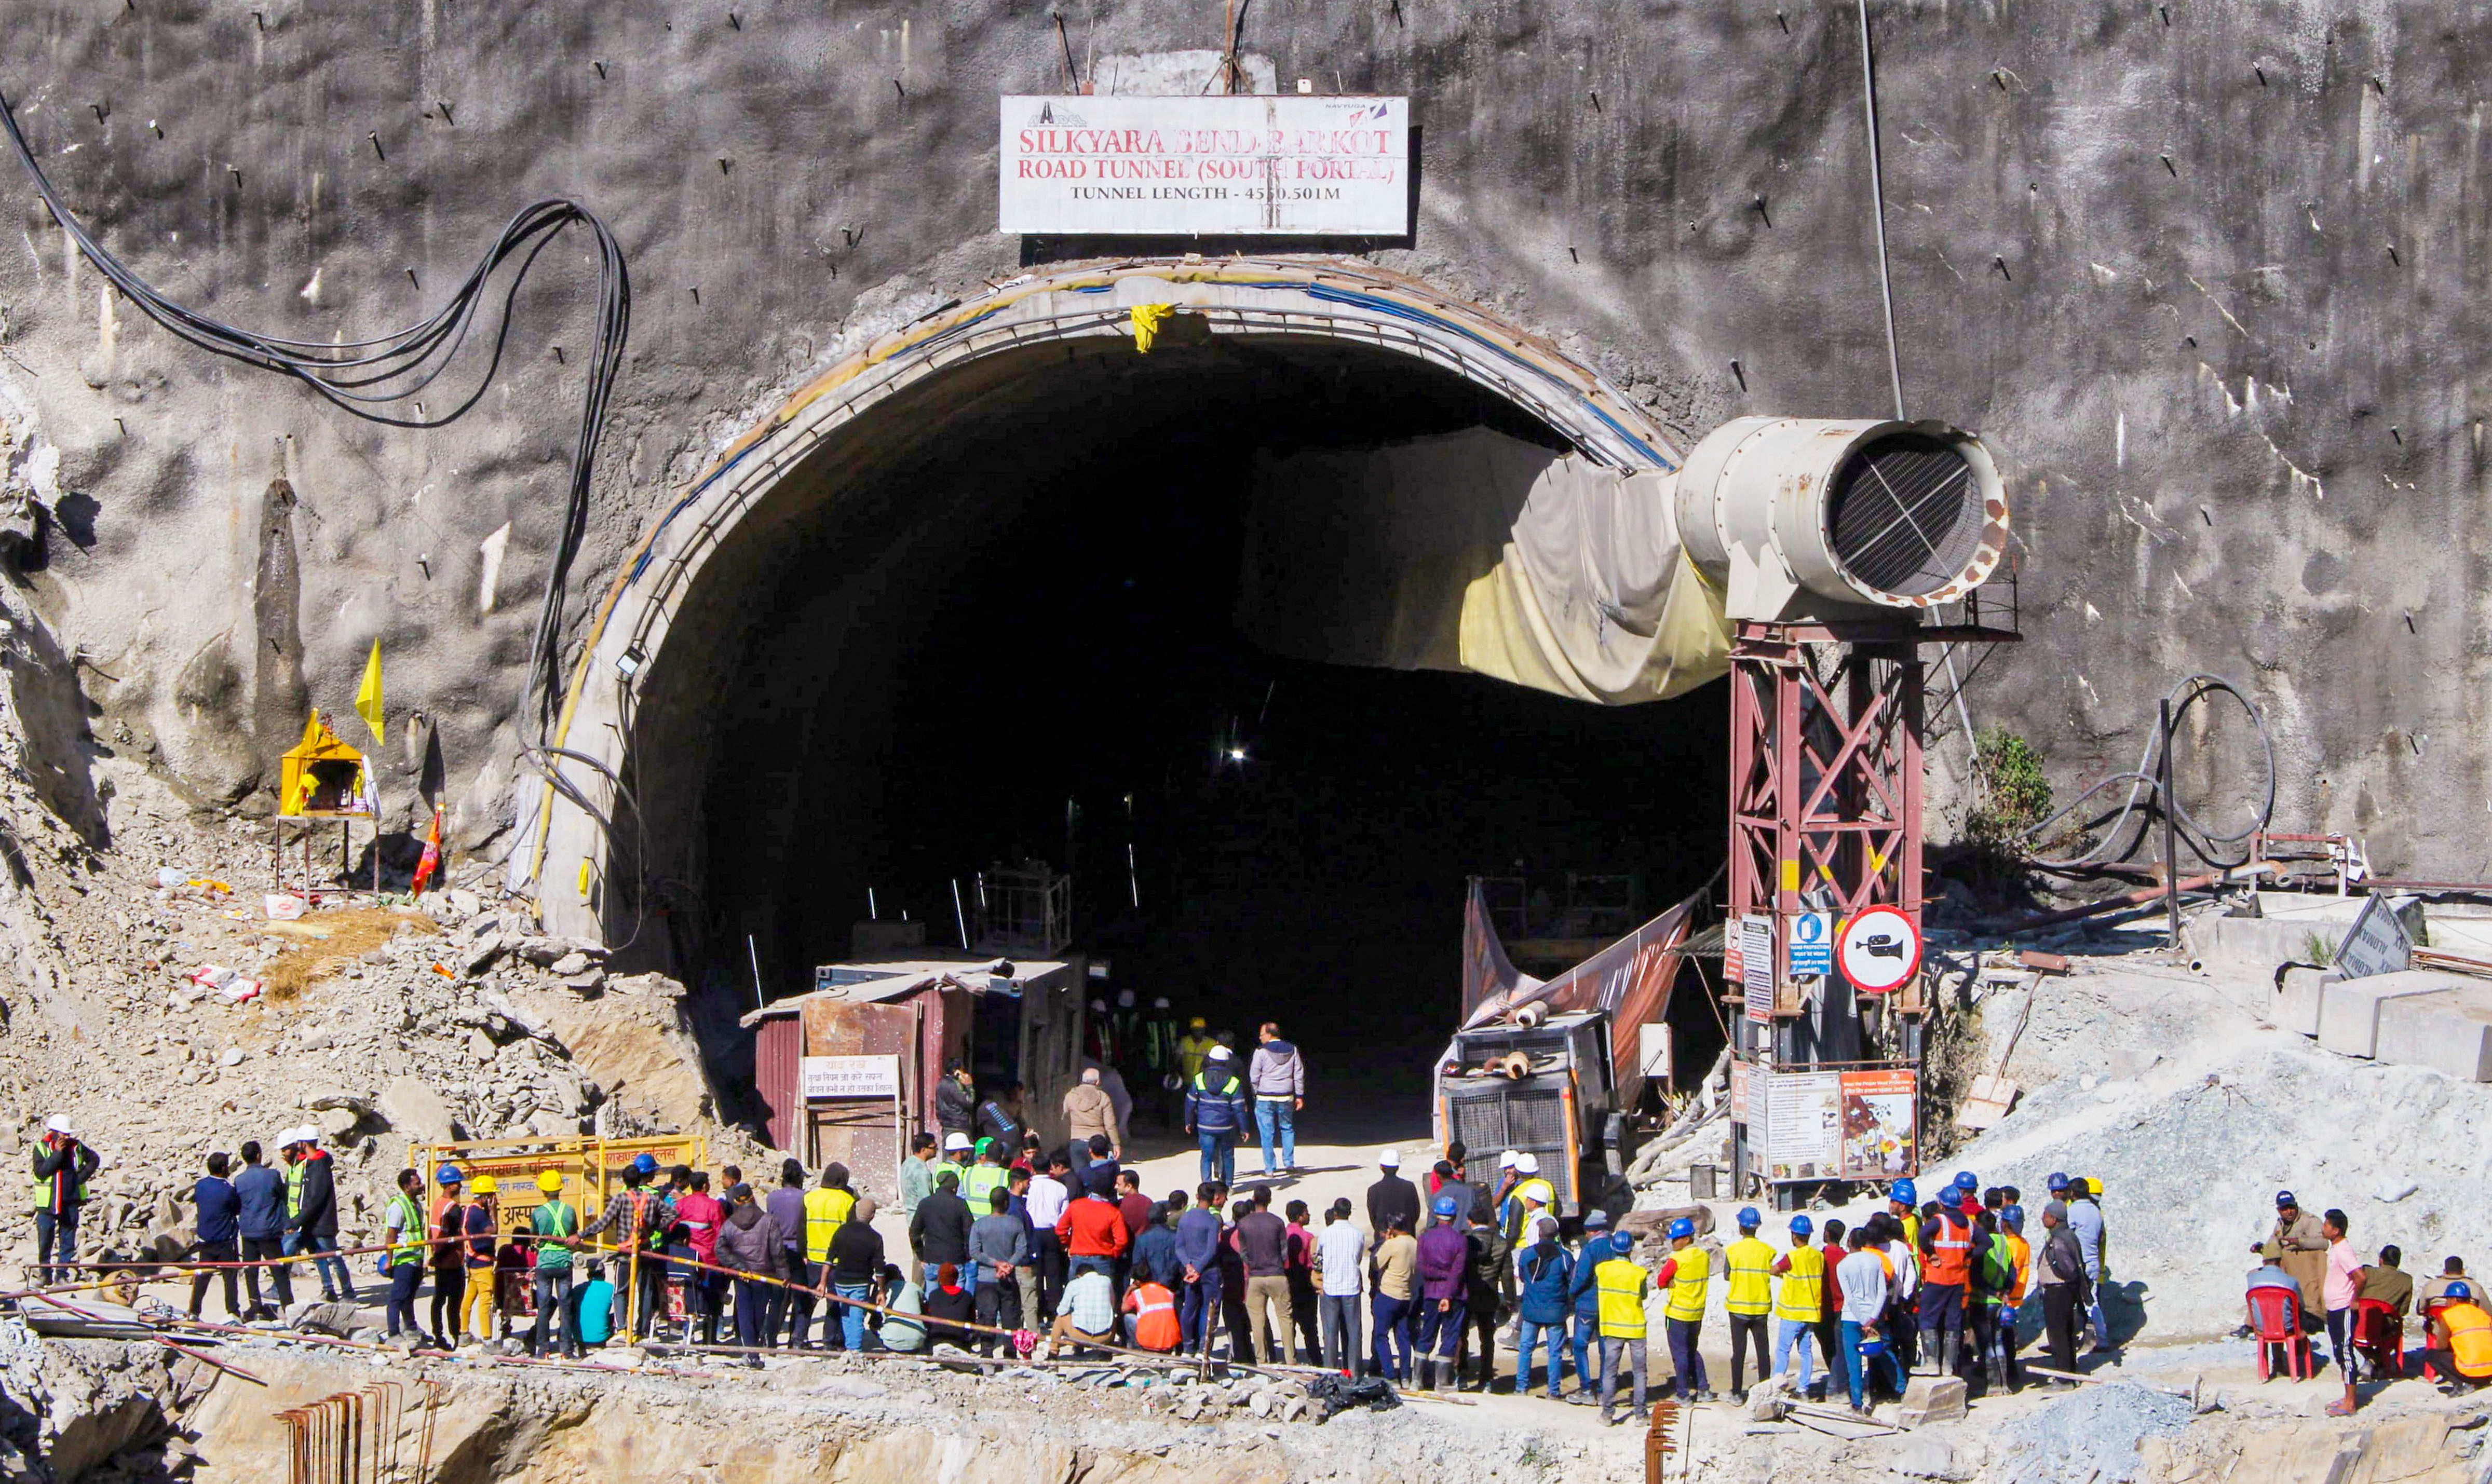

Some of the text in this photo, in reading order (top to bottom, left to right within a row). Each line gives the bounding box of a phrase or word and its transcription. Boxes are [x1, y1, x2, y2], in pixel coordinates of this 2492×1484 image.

[1020, 130, 1166, 154] SILKYARA
[1267, 129, 1391, 154] BARKOT
[1018, 159, 1394, 184] ROAD TUNNEL (SOUTH PORTAL)
[1071, 187, 1146, 200] TUNNEL
[1152, 187, 1227, 200] LENGTH
